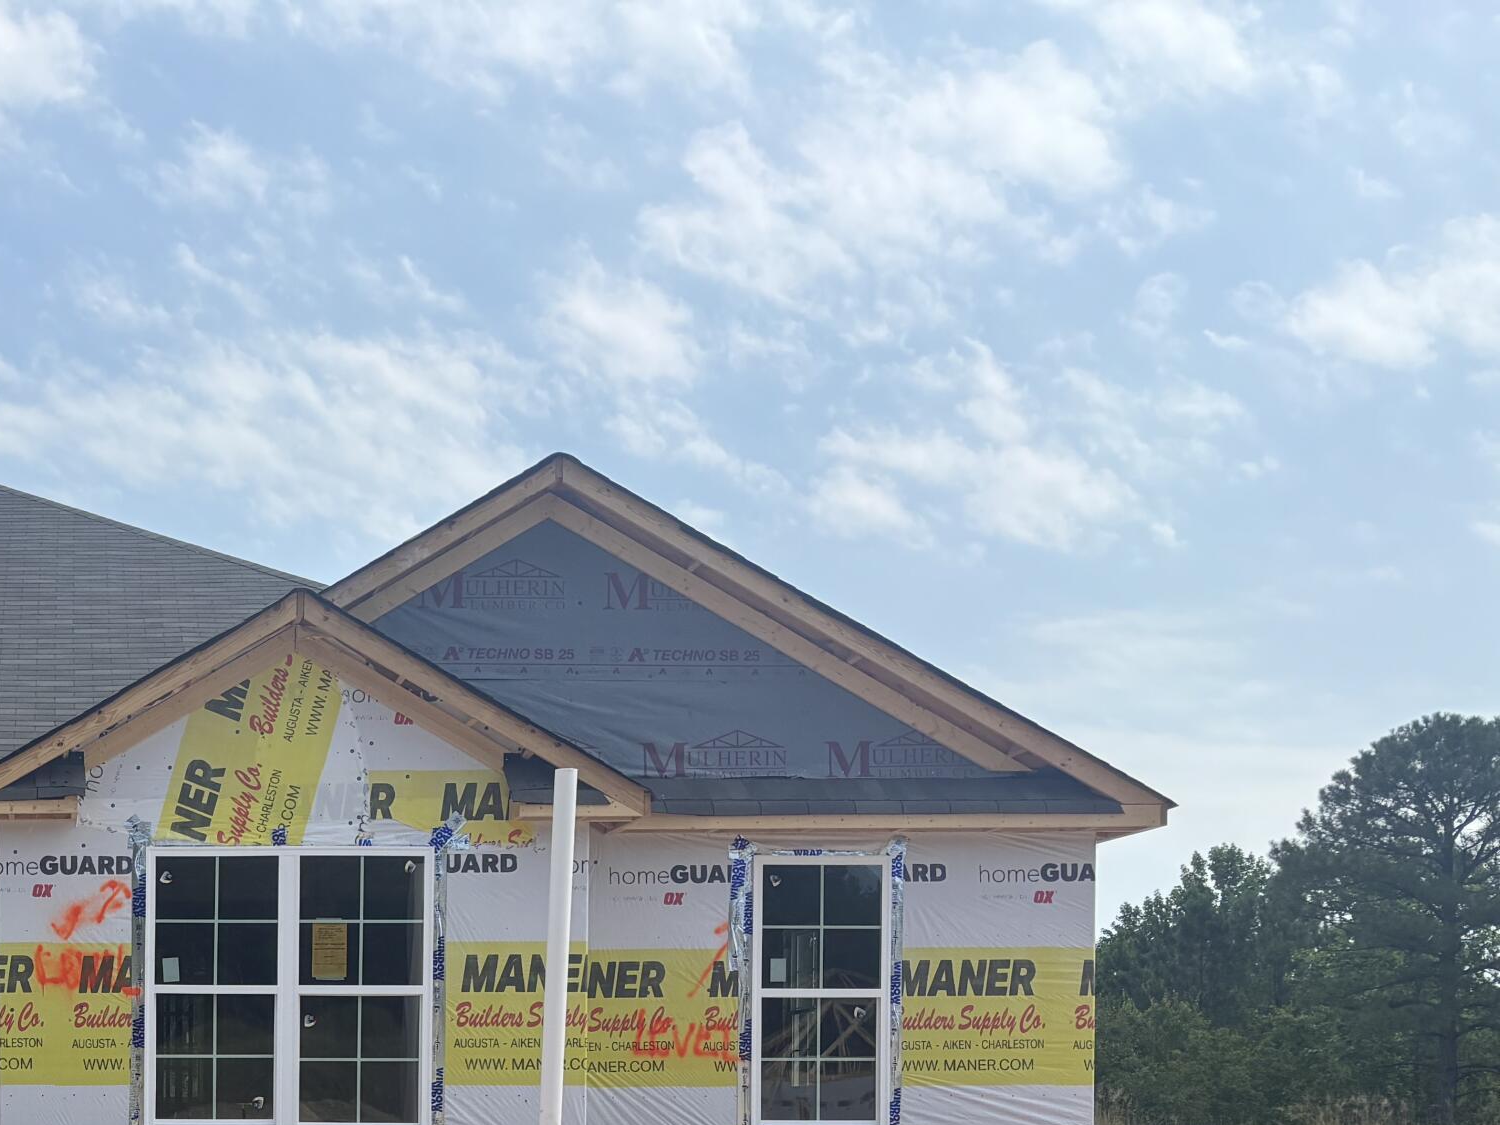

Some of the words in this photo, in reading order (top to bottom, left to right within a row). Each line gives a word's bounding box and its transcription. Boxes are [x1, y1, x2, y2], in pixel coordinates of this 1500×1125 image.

[467, 648, 530, 661] TECHNO
[534, 648, 554, 661] SB
[557, 648, 575, 661] 25
[652, 649, 716, 662] TECHNO
[719, 650, 739, 662] SB
[743, 650, 761, 662] 25
[249, 668, 289, 736] Builders
[305, 694, 328, 736] WWW.
[283, 697, 303, 743] AUGUSTA
[639, 742, 787, 778] MULHERIN
[235, 763, 263, 791] Co.
[170, 759, 227, 842] NER
[256, 769, 282, 834] CHARLESTON
[216, 787, 266, 846] Supply
[32, 883, 53, 898] OX
[663, 892, 685, 906] OX
[1033, 890, 1055, 904] OX
[901, 959, 1036, 997] MANER
[17, 1001, 44, 1032] Co.
[73, 1002, 133, 1028] Builder
[455, 1001, 524, 1028] Builders
[588, 1006, 647, 1038] Supply
[958, 1004, 1016, 1036] Supply
[1020, 1003, 1046, 1034] Co.
[71, 1038, 117, 1049] AUGUSTA
[453, 1038, 500, 1049] AUGUSTA
[510, 1038, 541, 1048] AIKEN
[611, 1040, 675, 1051] CHARLESTON
[943, 1040, 972, 1050] AIKEN
[981, 1039, 1045, 1050] CHARLESTON
[83, 1058, 125, 1071] WWW.
[465, 1058, 508, 1071] WWW.
[943, 1058, 1034, 1071] MANER.COM
